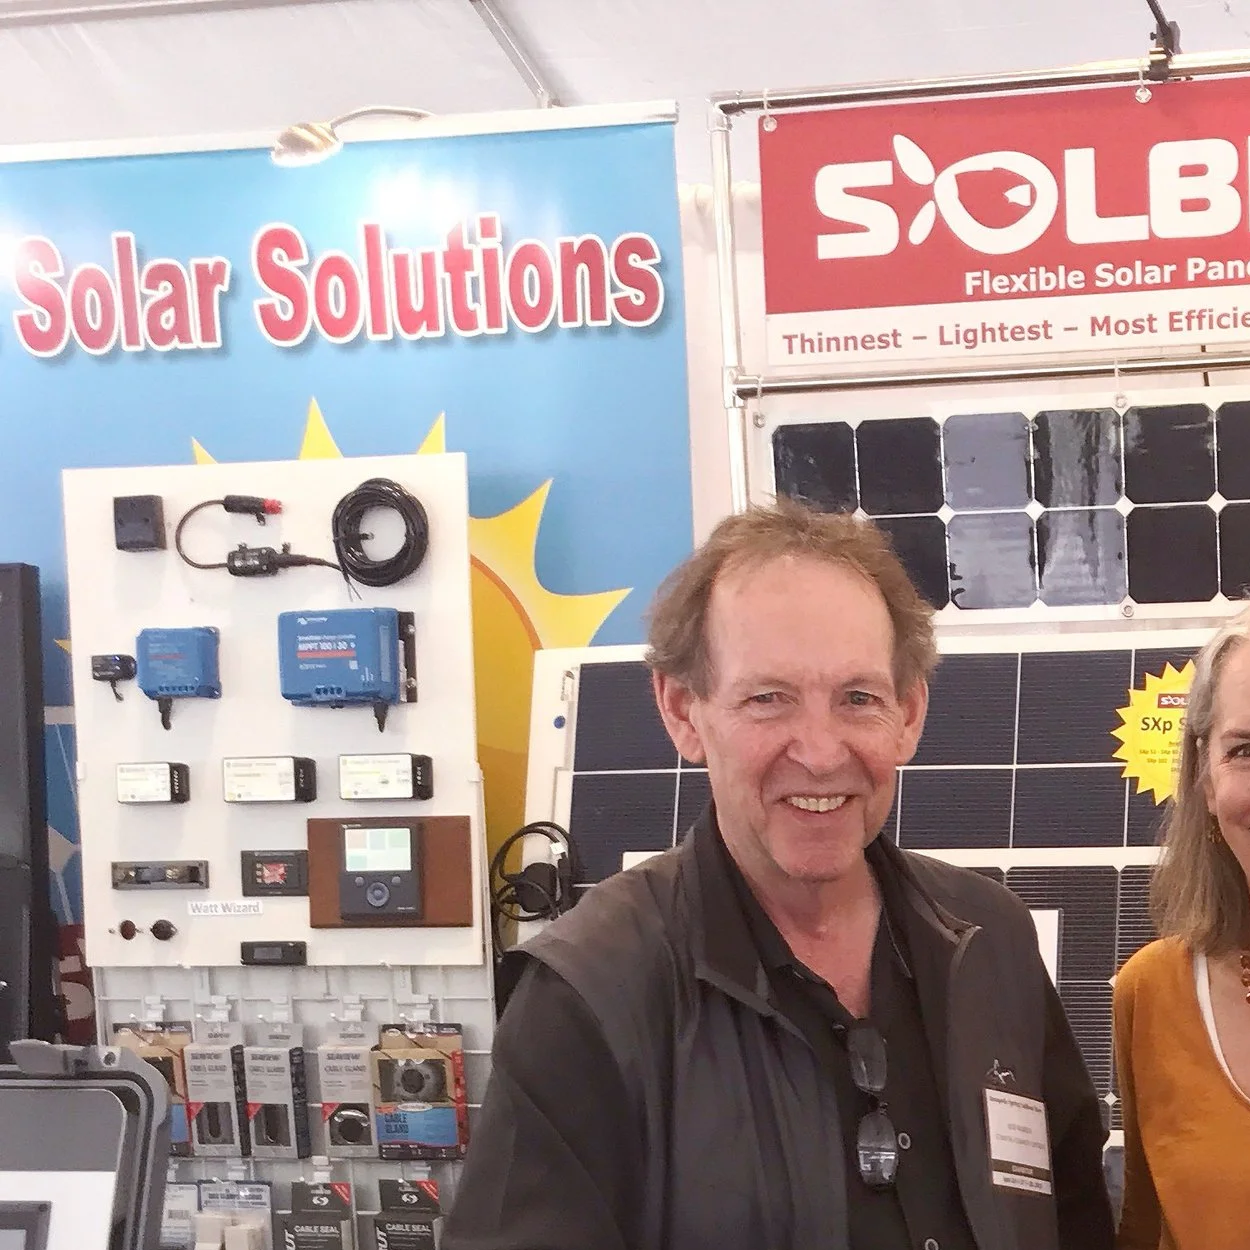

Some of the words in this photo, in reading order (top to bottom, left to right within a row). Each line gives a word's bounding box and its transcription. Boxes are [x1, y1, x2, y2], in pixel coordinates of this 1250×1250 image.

[12, 231, 231, 358] Solar
[252, 212, 664, 346] Solutions
[965, 265, 1086, 296] Flexible
[1095, 258, 1177, 288] Solar
[783, 328, 903, 355] Thinnest
[938, 319, 1054, 350] Lightest
[1090, 313, 1158, 338] Most
[1160, 694, 1189, 706] SOL
[1141, 716, 1174, 735] SXp
[190, 902, 220, 914] Watt
[221, 901, 260, 914] Wizard
[293, 1224, 319, 1233] CABLE
[319, 1225, 340, 1234] SEAL
[385, 1223, 411, 1232] CABLE
[411, 1224, 432, 1233] SEAL
